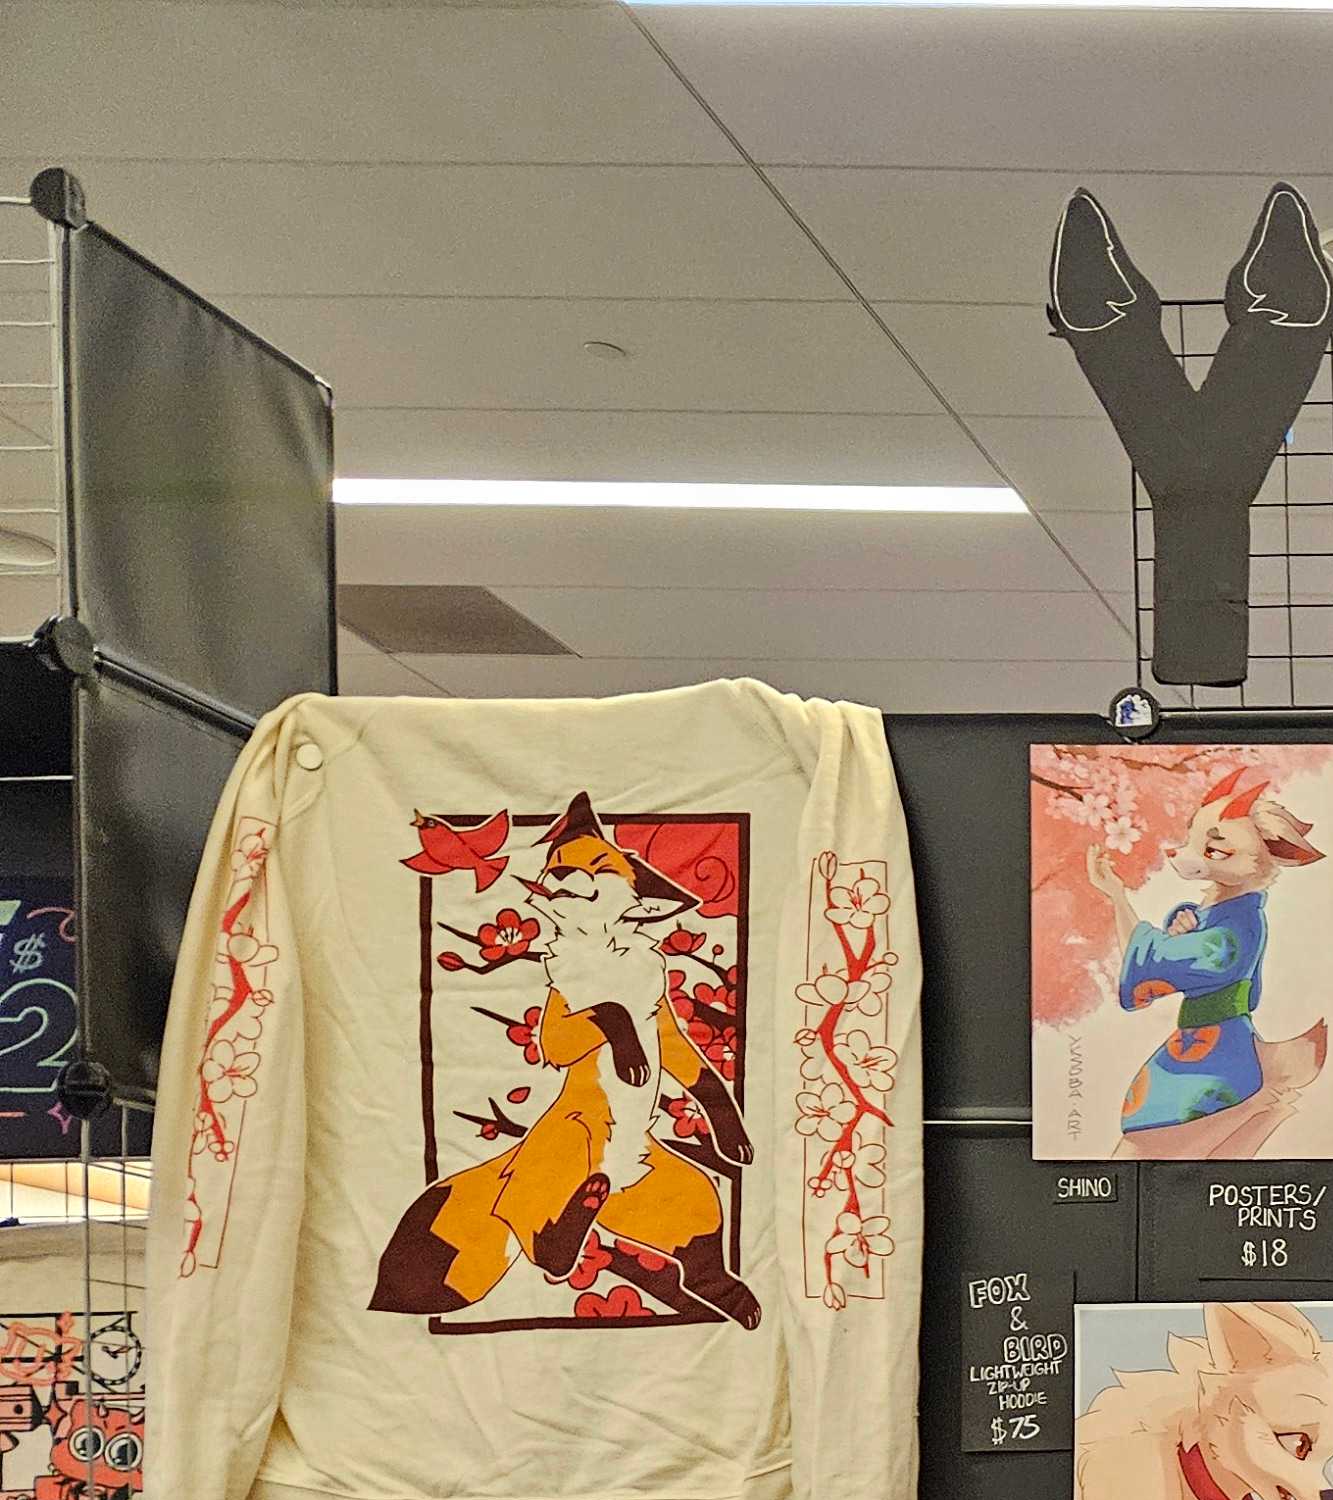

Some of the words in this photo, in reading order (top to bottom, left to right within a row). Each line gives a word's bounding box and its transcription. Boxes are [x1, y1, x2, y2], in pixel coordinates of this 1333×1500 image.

[1057, 1177, 1112, 1198] SHINO
[1208, 1184, 1328, 1207] POSTERS/
[1237, 1206, 1317, 1231] PRINTS
[1241, 1239, 1289, 1268] $18
[968, 1273, 1031, 1308] FOX
[1009, 1306, 1028, 1331] &
[1003, 1333, 1068, 1363] BIRD
[970, 1359, 1063, 1383] LIGHTWEIGHT
[986, 1380, 1031, 1397] ZIP-UP
[998, 1391, 1048, 1411] HOODIE
